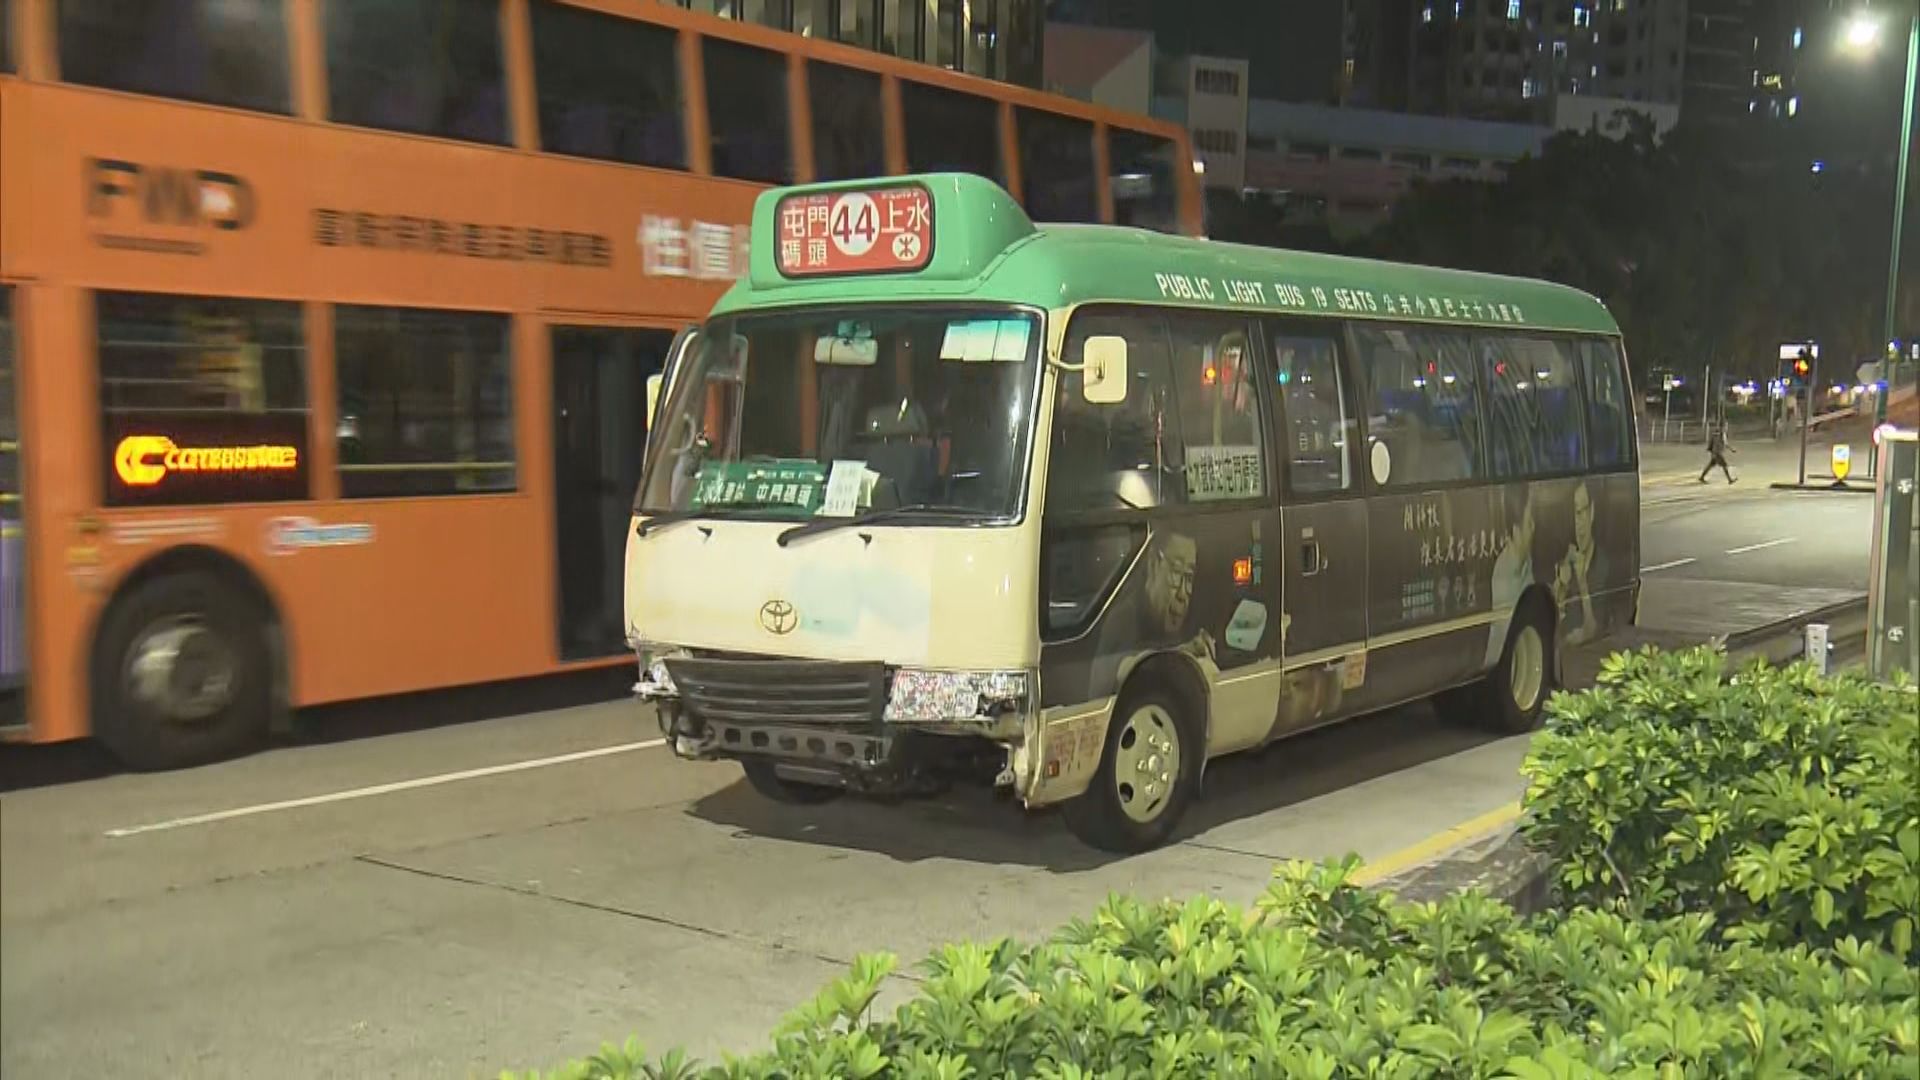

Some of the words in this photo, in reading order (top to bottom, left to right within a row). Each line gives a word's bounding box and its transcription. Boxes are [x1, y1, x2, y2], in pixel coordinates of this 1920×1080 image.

[82, 156, 257, 230] FWD
[783, 204, 830, 238] 屯門
[833, 203, 875, 244] 44
[881, 198, 930, 233] 上水
[638, 214, 753, 279] 性值
[782, 239, 829, 267] 碼頭
[1155, 272, 1214, 300] PUBLIC
[1222, 279, 1266, 304] LIGHT
[1274, 284, 1305, 307] BUS
[1311, 286, 1327, 308] 19
[1334, 288, 1377, 312] SEATS
